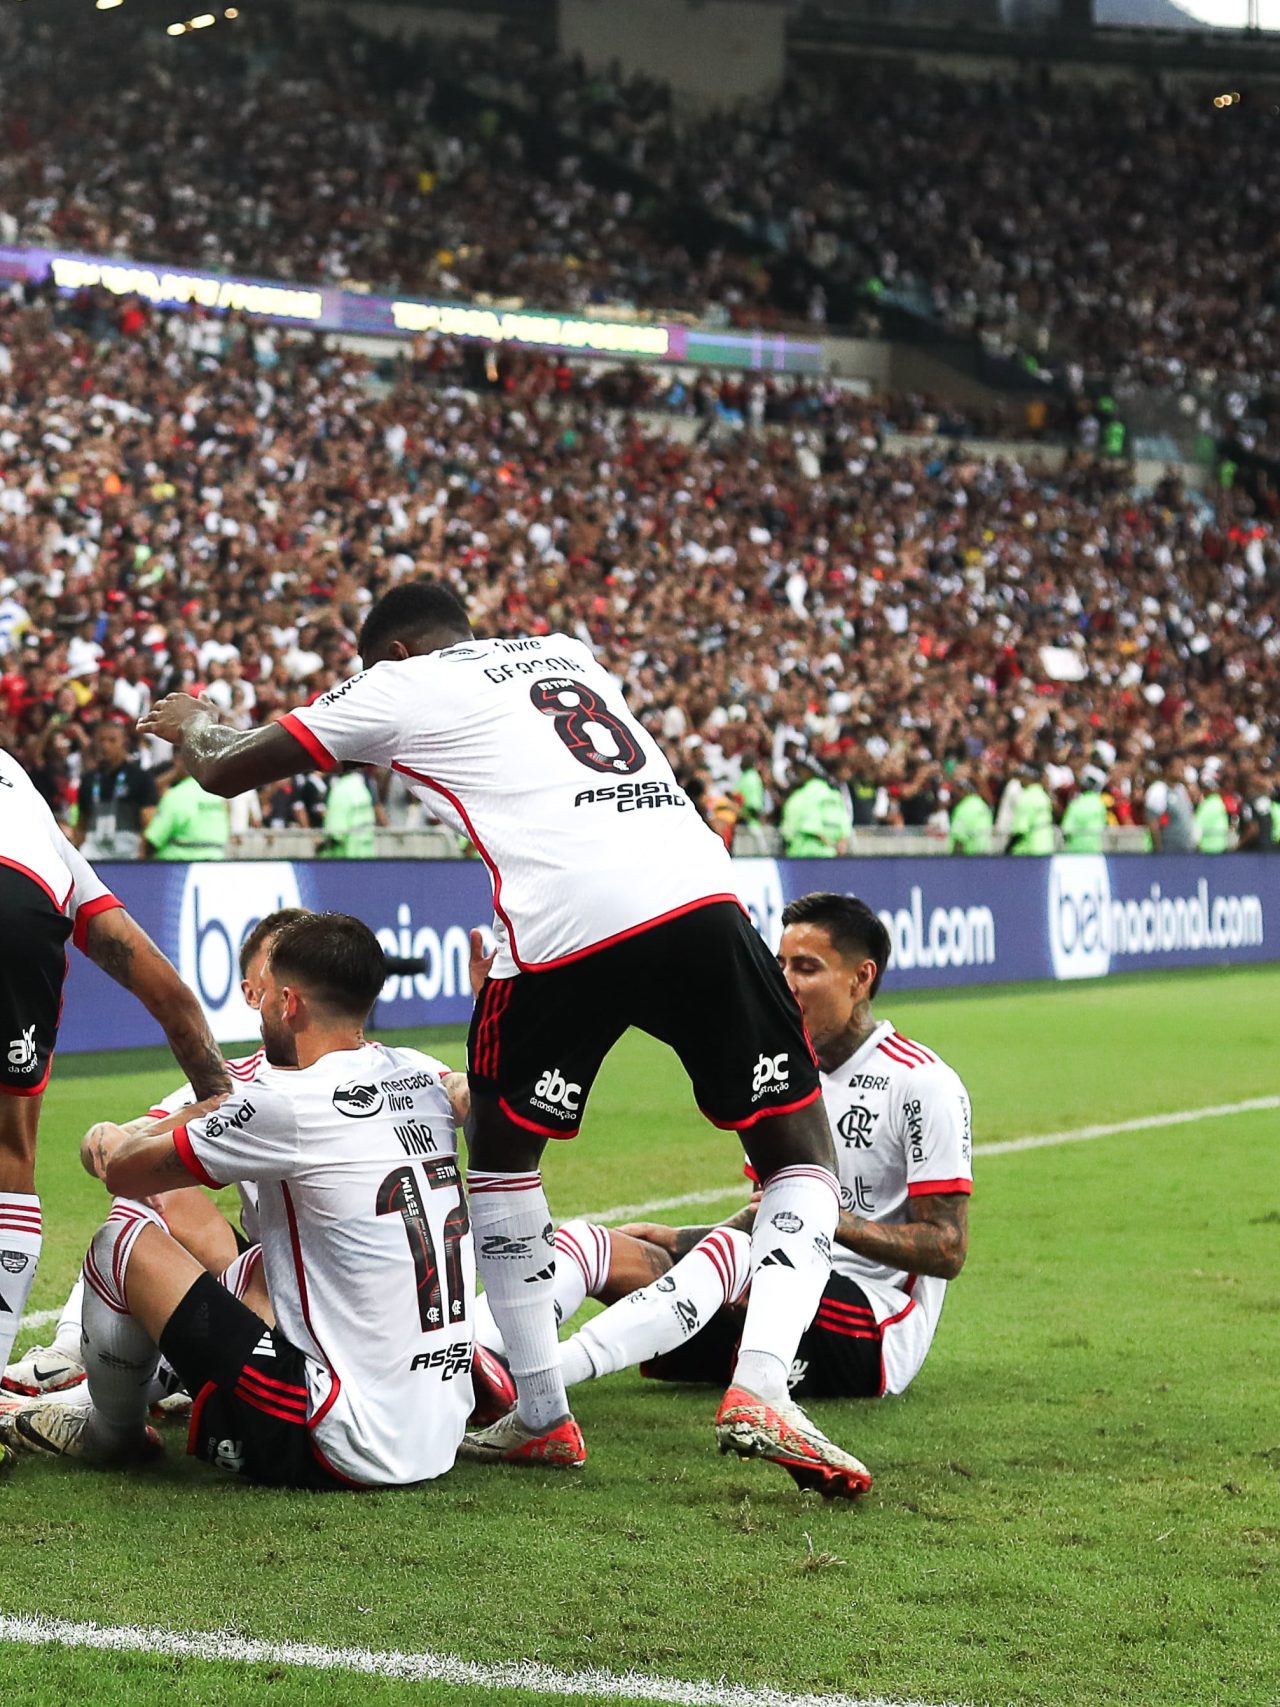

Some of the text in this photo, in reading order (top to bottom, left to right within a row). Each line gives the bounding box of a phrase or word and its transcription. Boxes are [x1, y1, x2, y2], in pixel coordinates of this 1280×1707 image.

[530, 677, 646, 775] 8
[574, 781, 671, 807] ASSIST
[616, 794, 686, 813] CARD
[381, 1071, 434, 1093] mercado
[535, 1068, 582, 1111] abc
[388, 1094, 414, 1112] livre
[375, 1156, 471, 1334] 17
[441, 1358, 472, 1381] CAR
